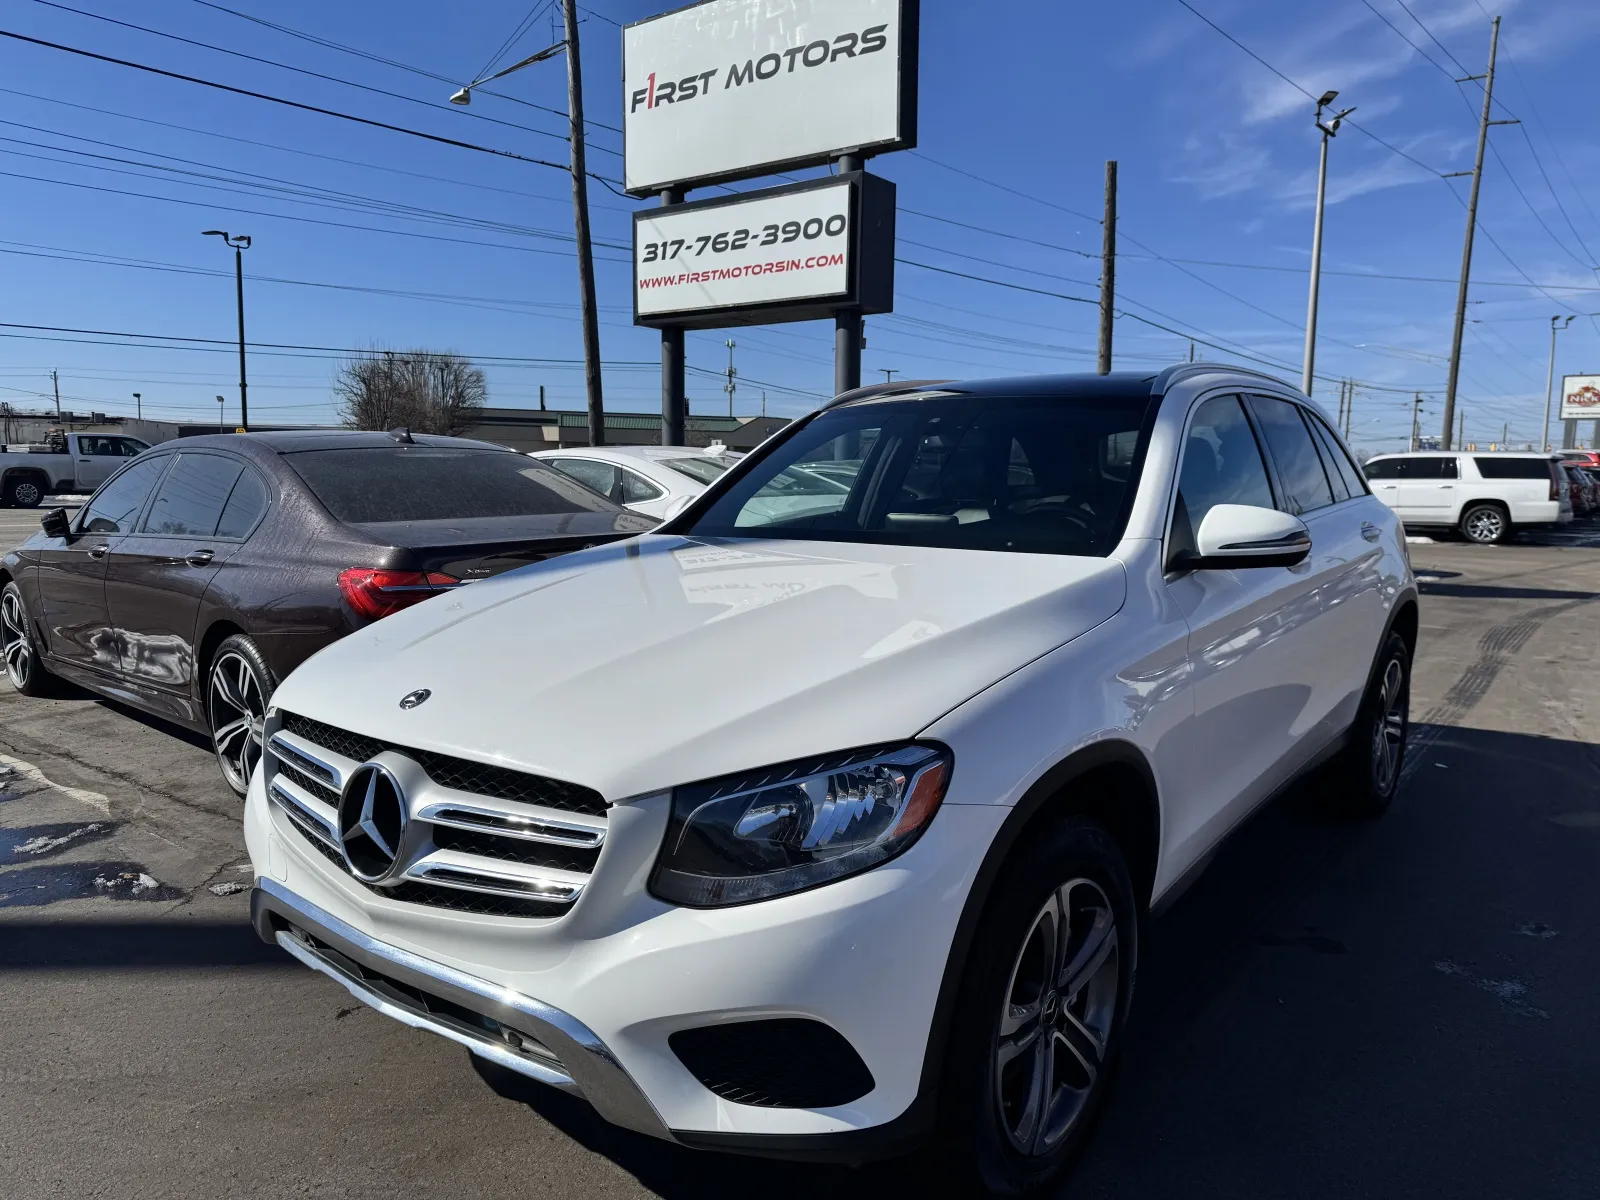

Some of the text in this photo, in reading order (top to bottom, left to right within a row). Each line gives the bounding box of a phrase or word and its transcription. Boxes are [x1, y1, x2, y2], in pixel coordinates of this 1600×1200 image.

[724, 24, 889, 90] MOTORS
[642, 214, 847, 264] 317-762-3900
[639, 253, 844, 290] WWW.FIRSTMOTORSIN.COM
